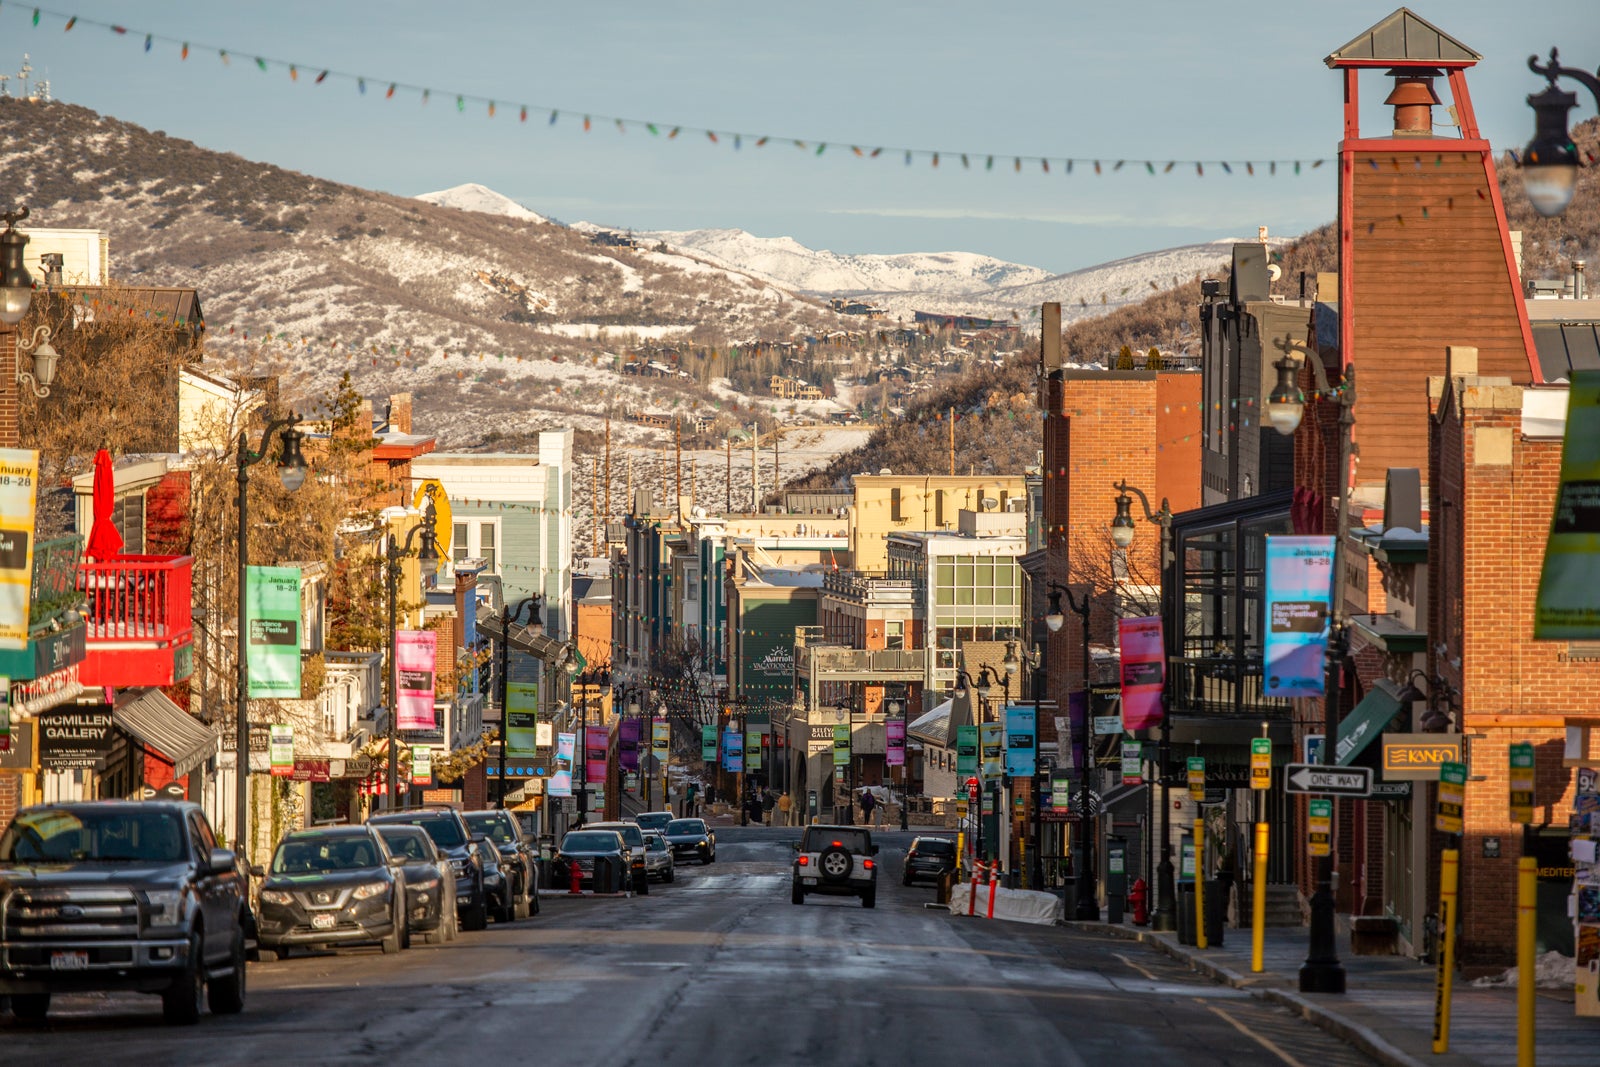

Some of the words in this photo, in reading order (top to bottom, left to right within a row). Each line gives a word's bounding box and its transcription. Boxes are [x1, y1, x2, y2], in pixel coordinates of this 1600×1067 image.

[1294, 548, 1330, 557] January
[268, 577, 298, 585] January
[1290, 610, 1318, 618] Festival
[40, 715, 112, 726] MCMILLEN
[46, 728, 106, 738] GALLERY
[1311, 774, 1333, 786] ONE
[1337, 775, 1361, 787] WAY
